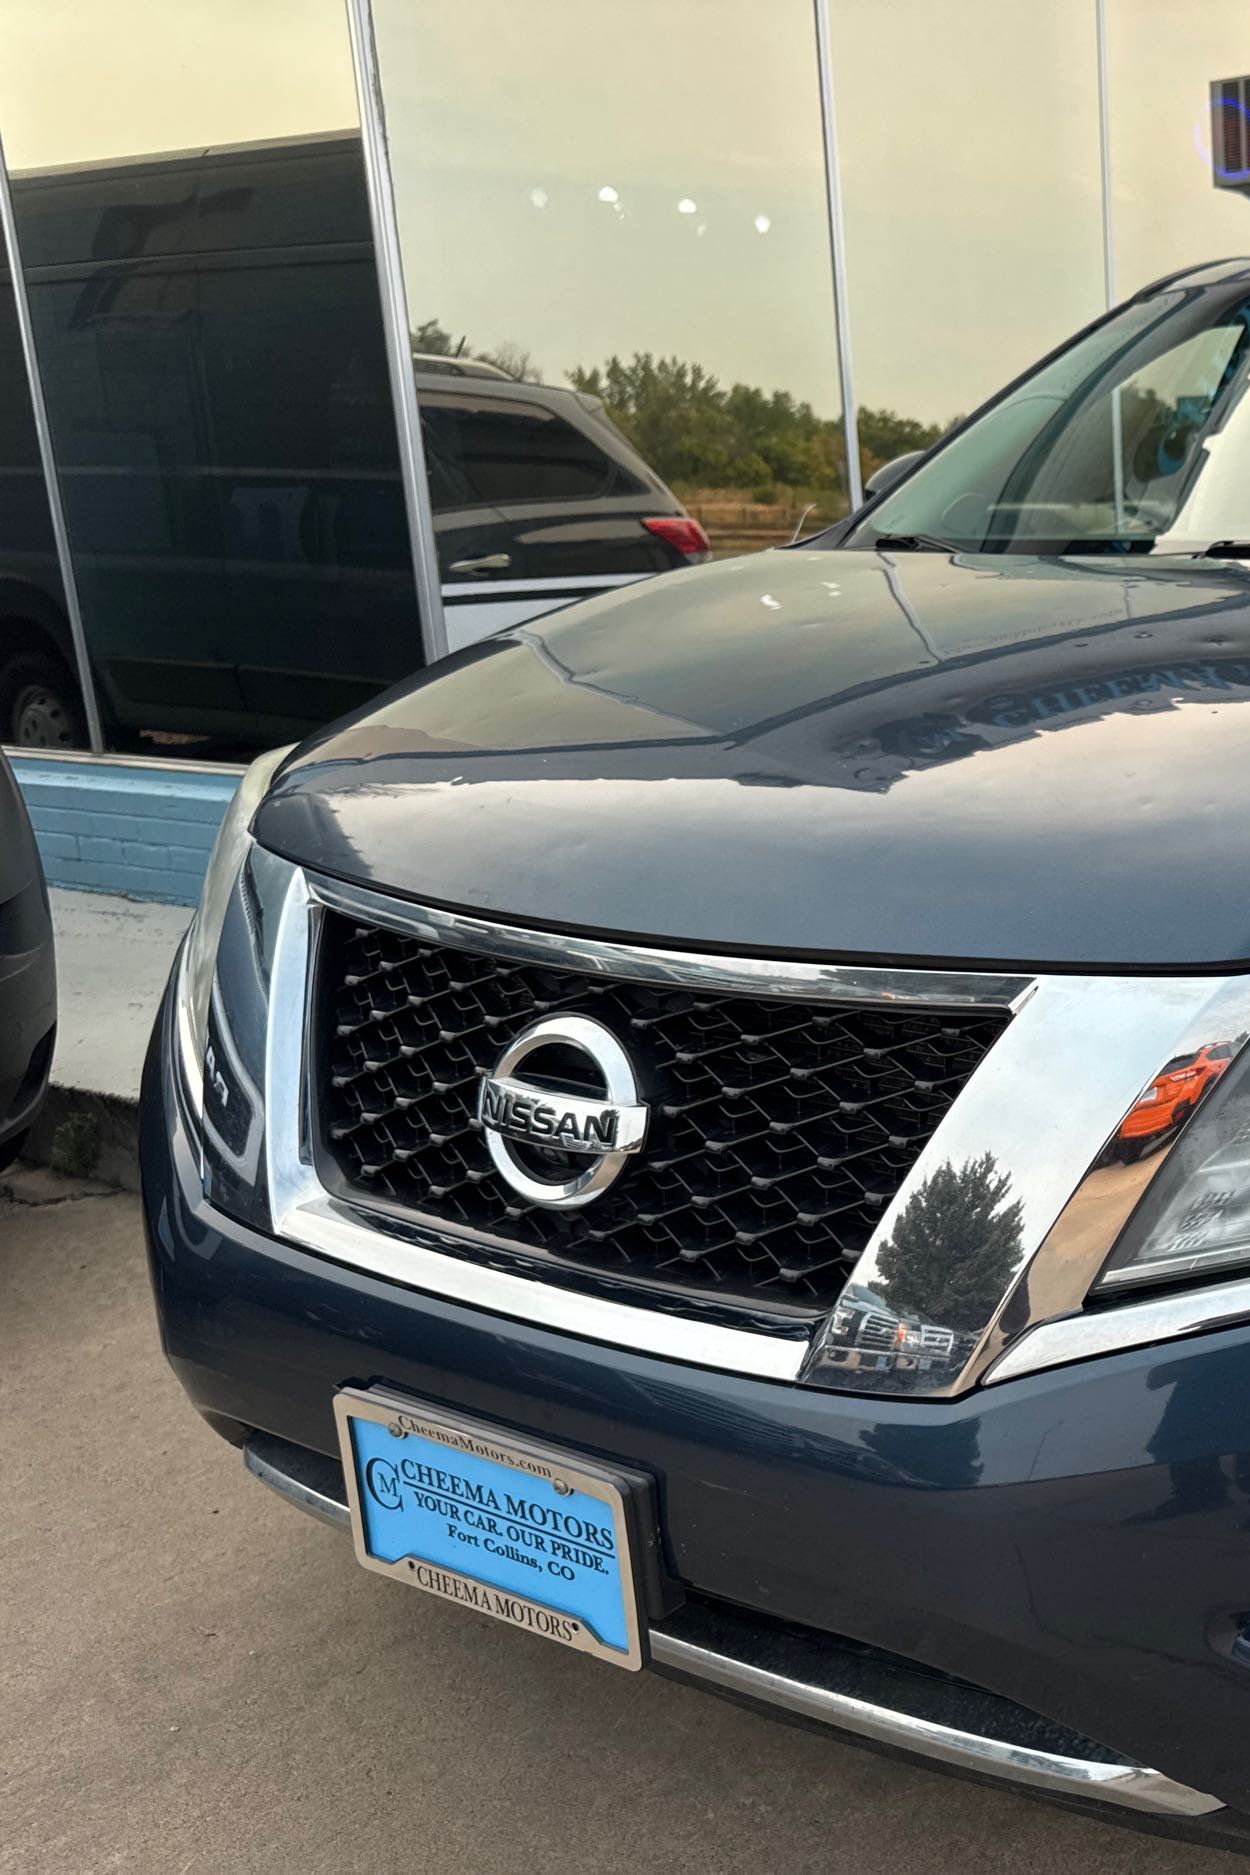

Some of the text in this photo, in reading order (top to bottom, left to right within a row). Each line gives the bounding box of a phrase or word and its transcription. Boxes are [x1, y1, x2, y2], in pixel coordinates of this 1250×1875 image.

[481, 1082, 620, 1148] NISSAN
[398, 1415, 553, 1478] CheemaMotors.com
[401, 1458, 614, 1550] CHEEMA MOTORS
[414, 1491, 462, 1521] YOUR
[506, 1523, 547, 1552] OUR
[550, 1540, 610, 1575] PRIDE.
[446, 1523, 576, 1581] Fort Collins, CO
[417, 1565, 573, 1641] CHEEMA MOTORS
